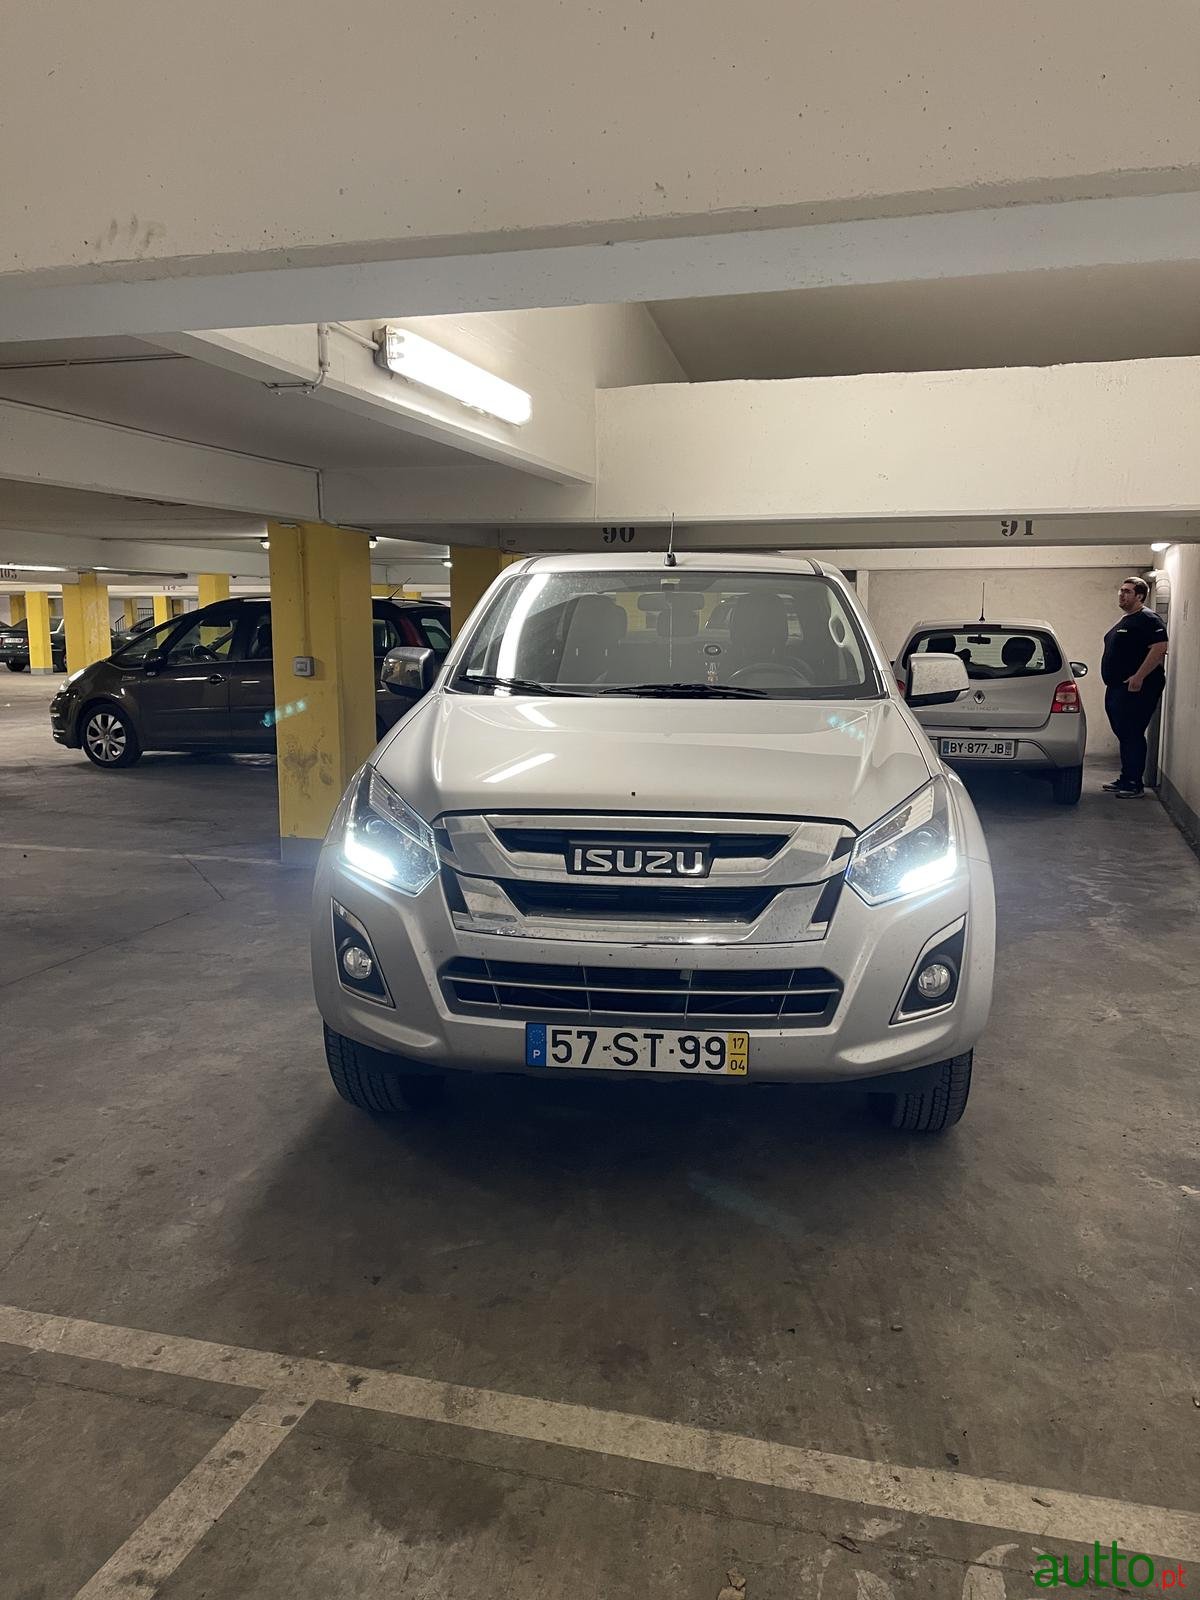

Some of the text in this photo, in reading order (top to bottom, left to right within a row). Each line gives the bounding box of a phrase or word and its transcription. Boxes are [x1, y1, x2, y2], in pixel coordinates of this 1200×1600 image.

[602, 527, 635, 543] 90
[1001, 520, 1034, 536] 91
[950, 742, 1004, 754] BY-877-JB
[574, 848, 703, 874] ISUZU
[533, 1029, 726, 1070] P 57-ST-99
[732, 1037, 744, 1049] 17
[730, 1060, 745, 1071] 04
